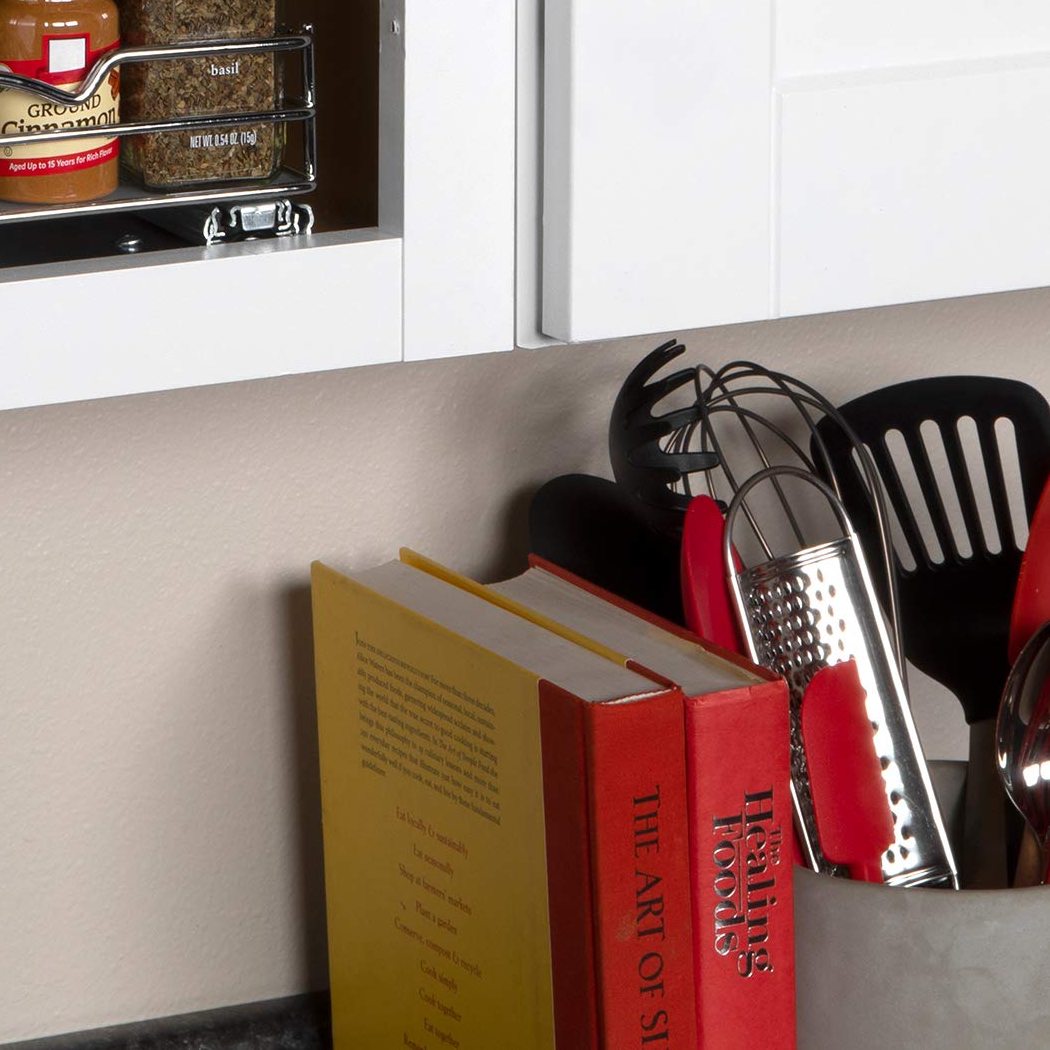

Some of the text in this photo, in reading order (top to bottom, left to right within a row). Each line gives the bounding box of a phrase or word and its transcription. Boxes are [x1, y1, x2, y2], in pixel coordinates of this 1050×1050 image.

[211, 62, 239, 76] basil
[9, 147, 113, 172] Aged Up to 15 Years for Rich Flavor
[190, 135, 201, 148] NET
[214, 133, 229, 146] 0.54
[240, 130, 256, 146] (15g)
[633, 785, 661, 858] THE
[769, 825, 783, 866] The
[713, 811, 746, 956] Foods
[737, 785, 778, 979] Healing
[635, 870, 666, 942] ART
[638, 951, 666, 998] OF
